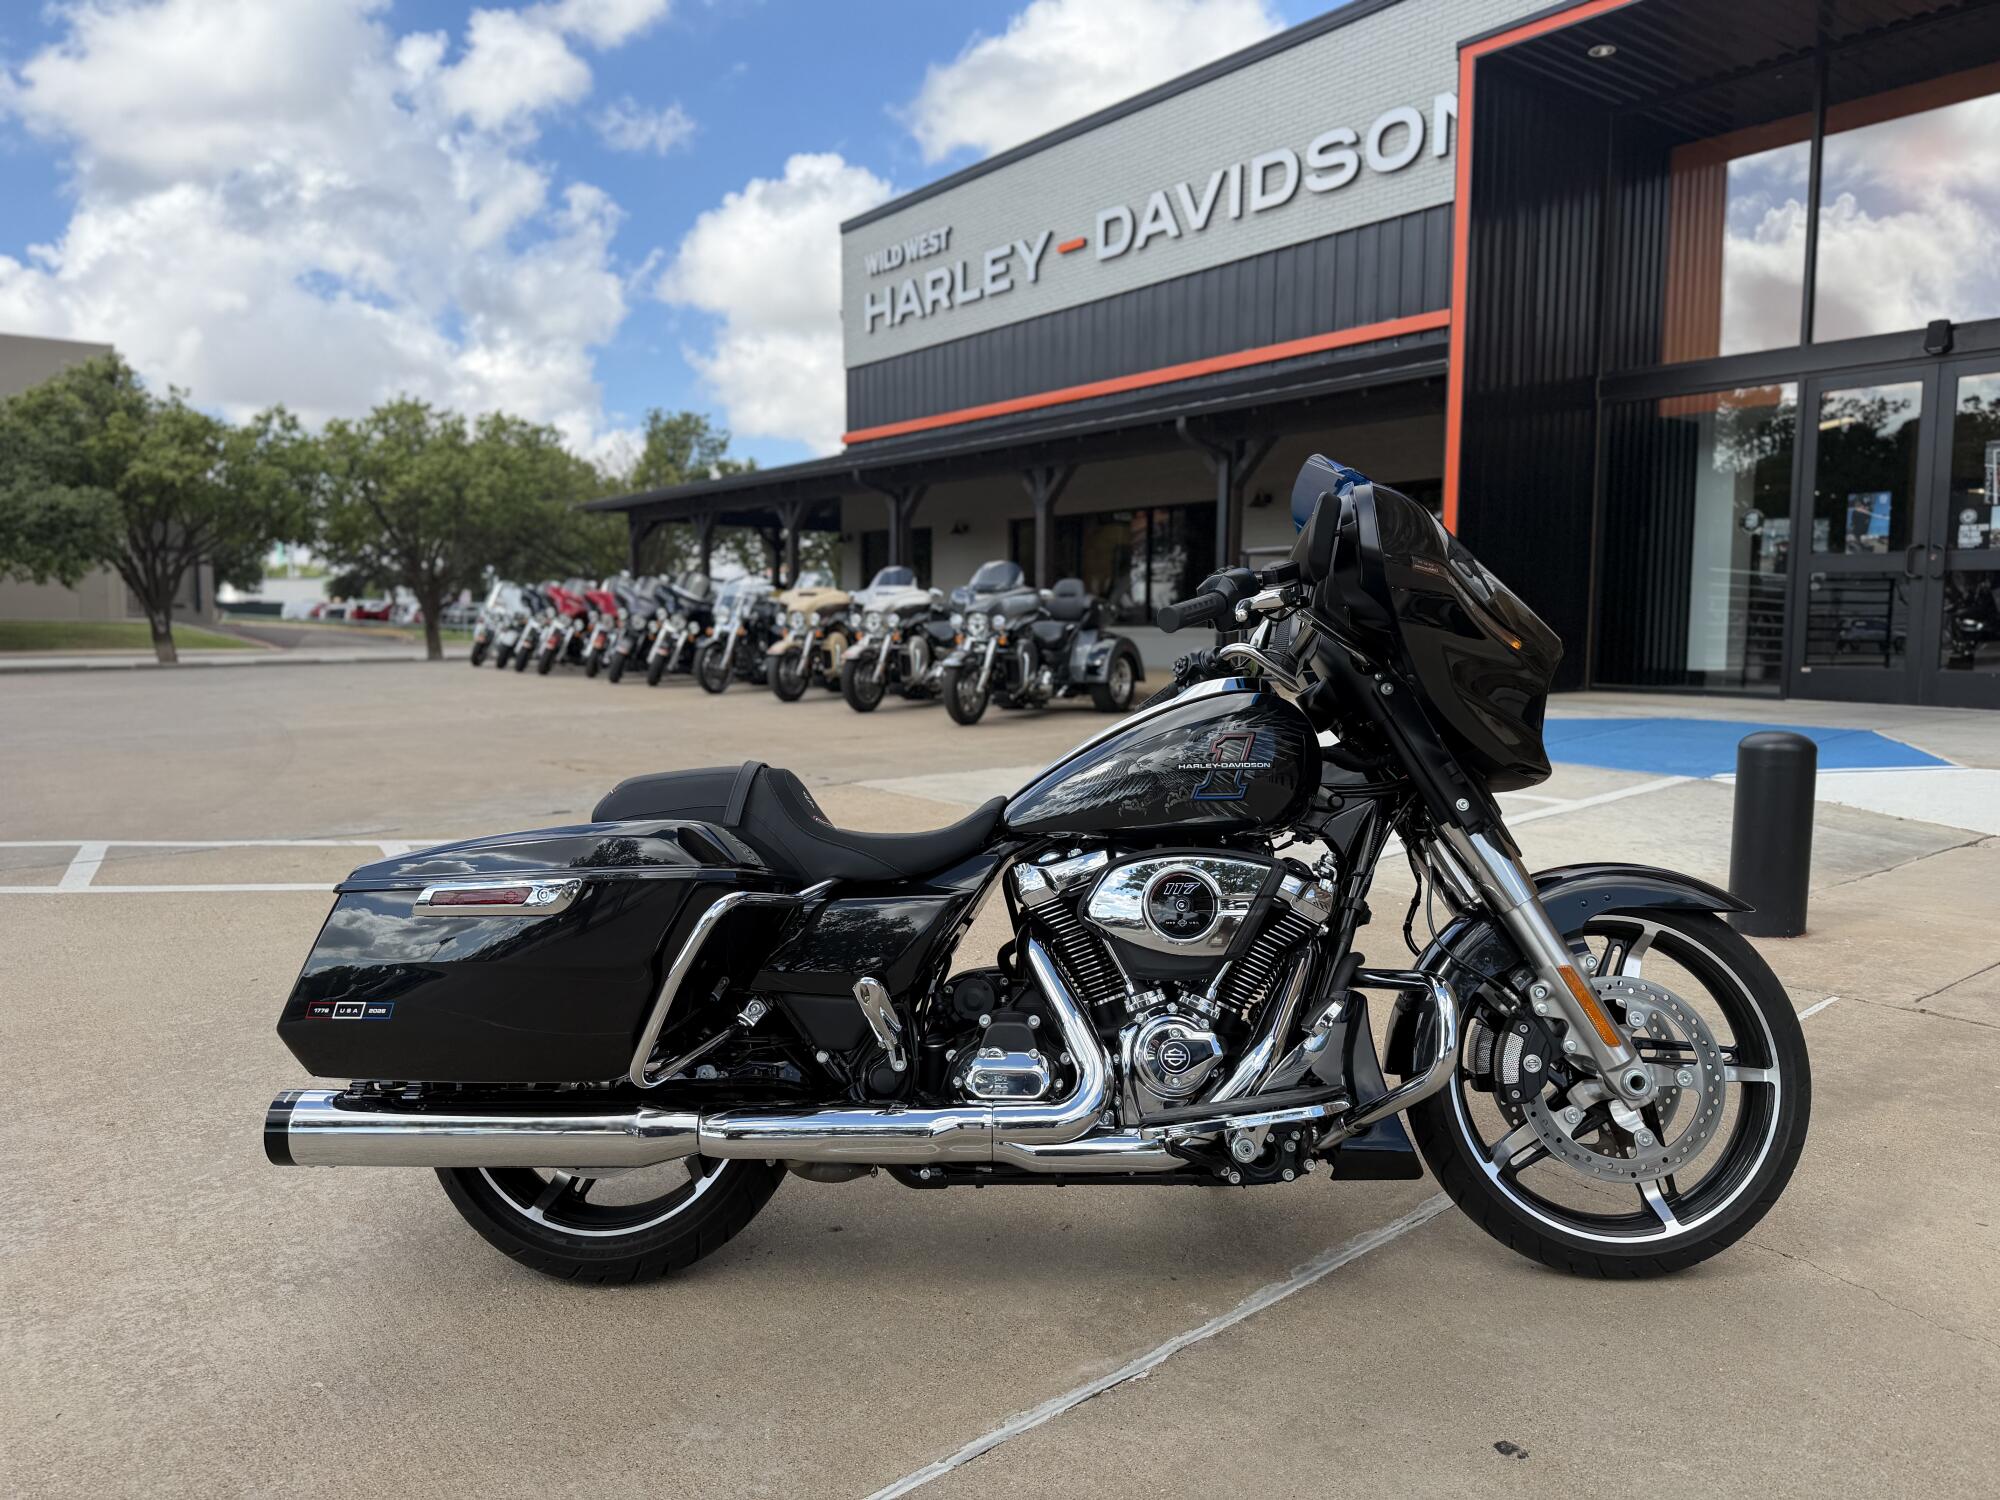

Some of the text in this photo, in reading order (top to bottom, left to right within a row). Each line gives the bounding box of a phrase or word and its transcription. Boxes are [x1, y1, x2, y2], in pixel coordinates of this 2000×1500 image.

[864, 226, 952, 276] WILD WEST
[1178, 762, 1271, 770] HARLEY-DAVIDSON
[1163, 882, 1201, 895] 117
